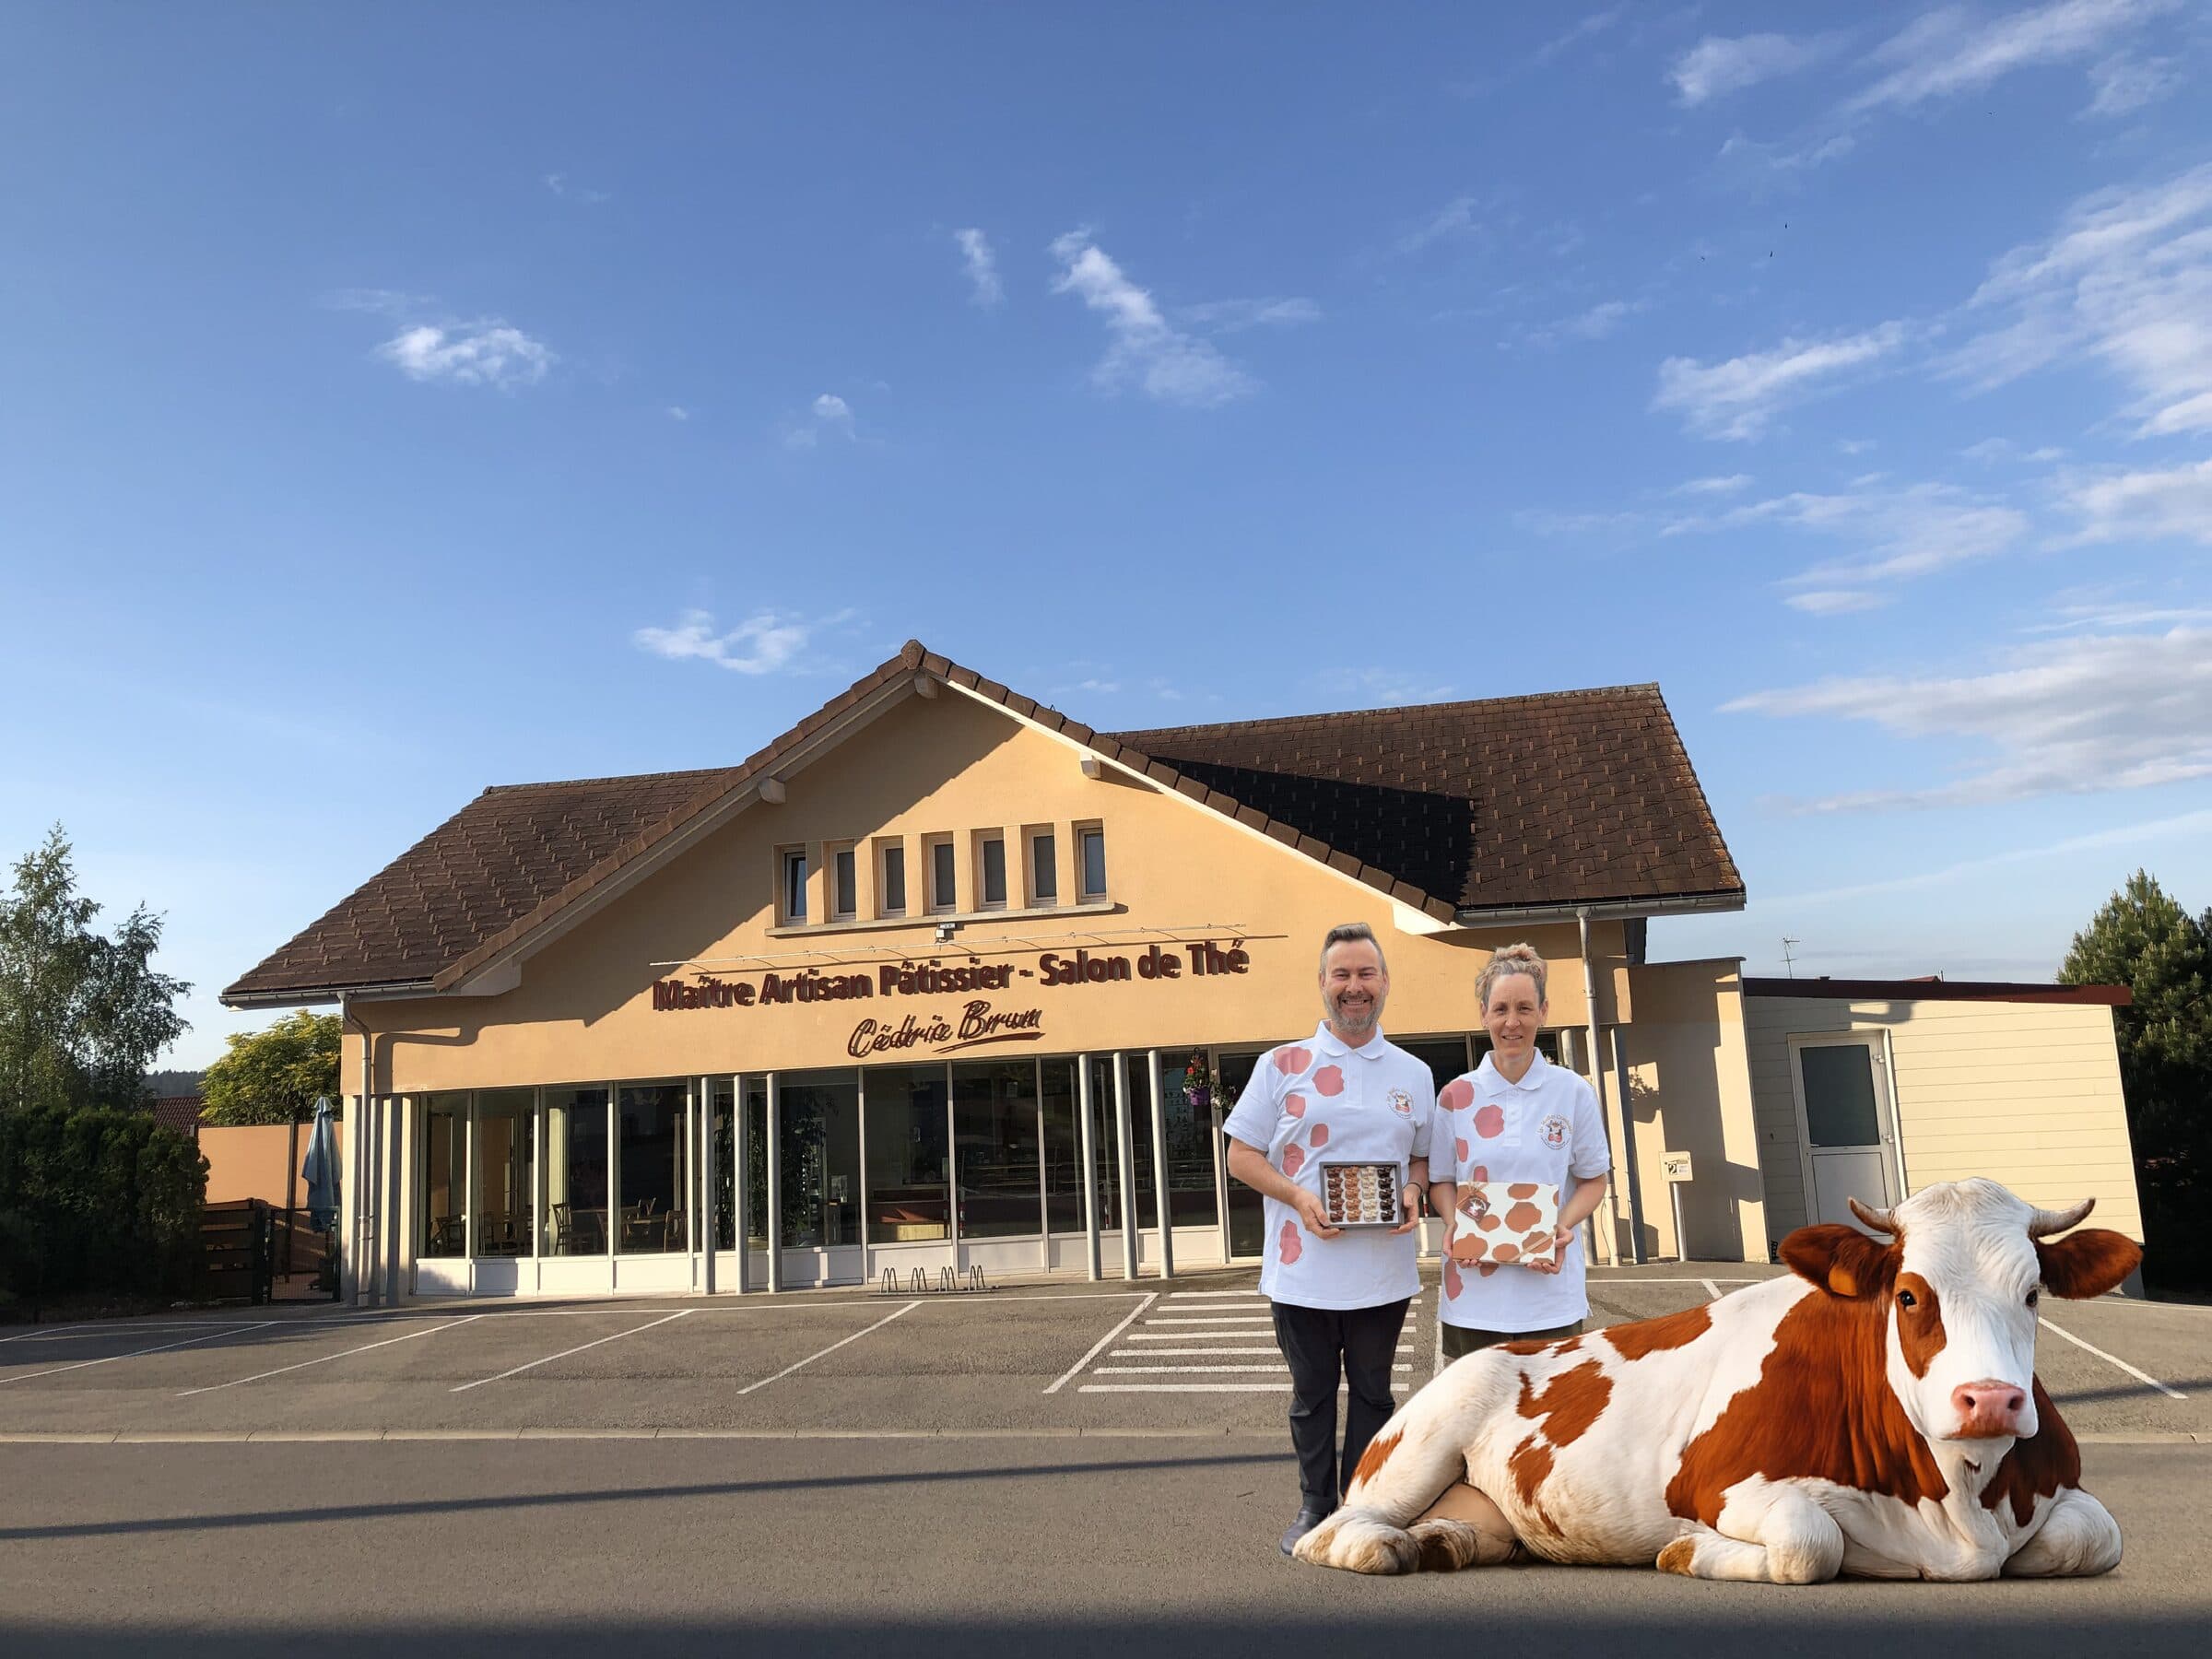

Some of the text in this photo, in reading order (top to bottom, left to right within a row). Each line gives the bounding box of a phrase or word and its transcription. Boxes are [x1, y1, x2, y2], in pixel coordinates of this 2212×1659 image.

[653, 975, 756, 1011] Maître
[759, 969, 873, 1005] Artisan
[878, 958, 1015, 995] Pâtissier
[1040, 948, 1132, 987] Salon
[1137, 945, 1182, 979] de
[1186, 938, 1250, 976] Thé
[847, 999, 1043, 1058] Cédric Brun
